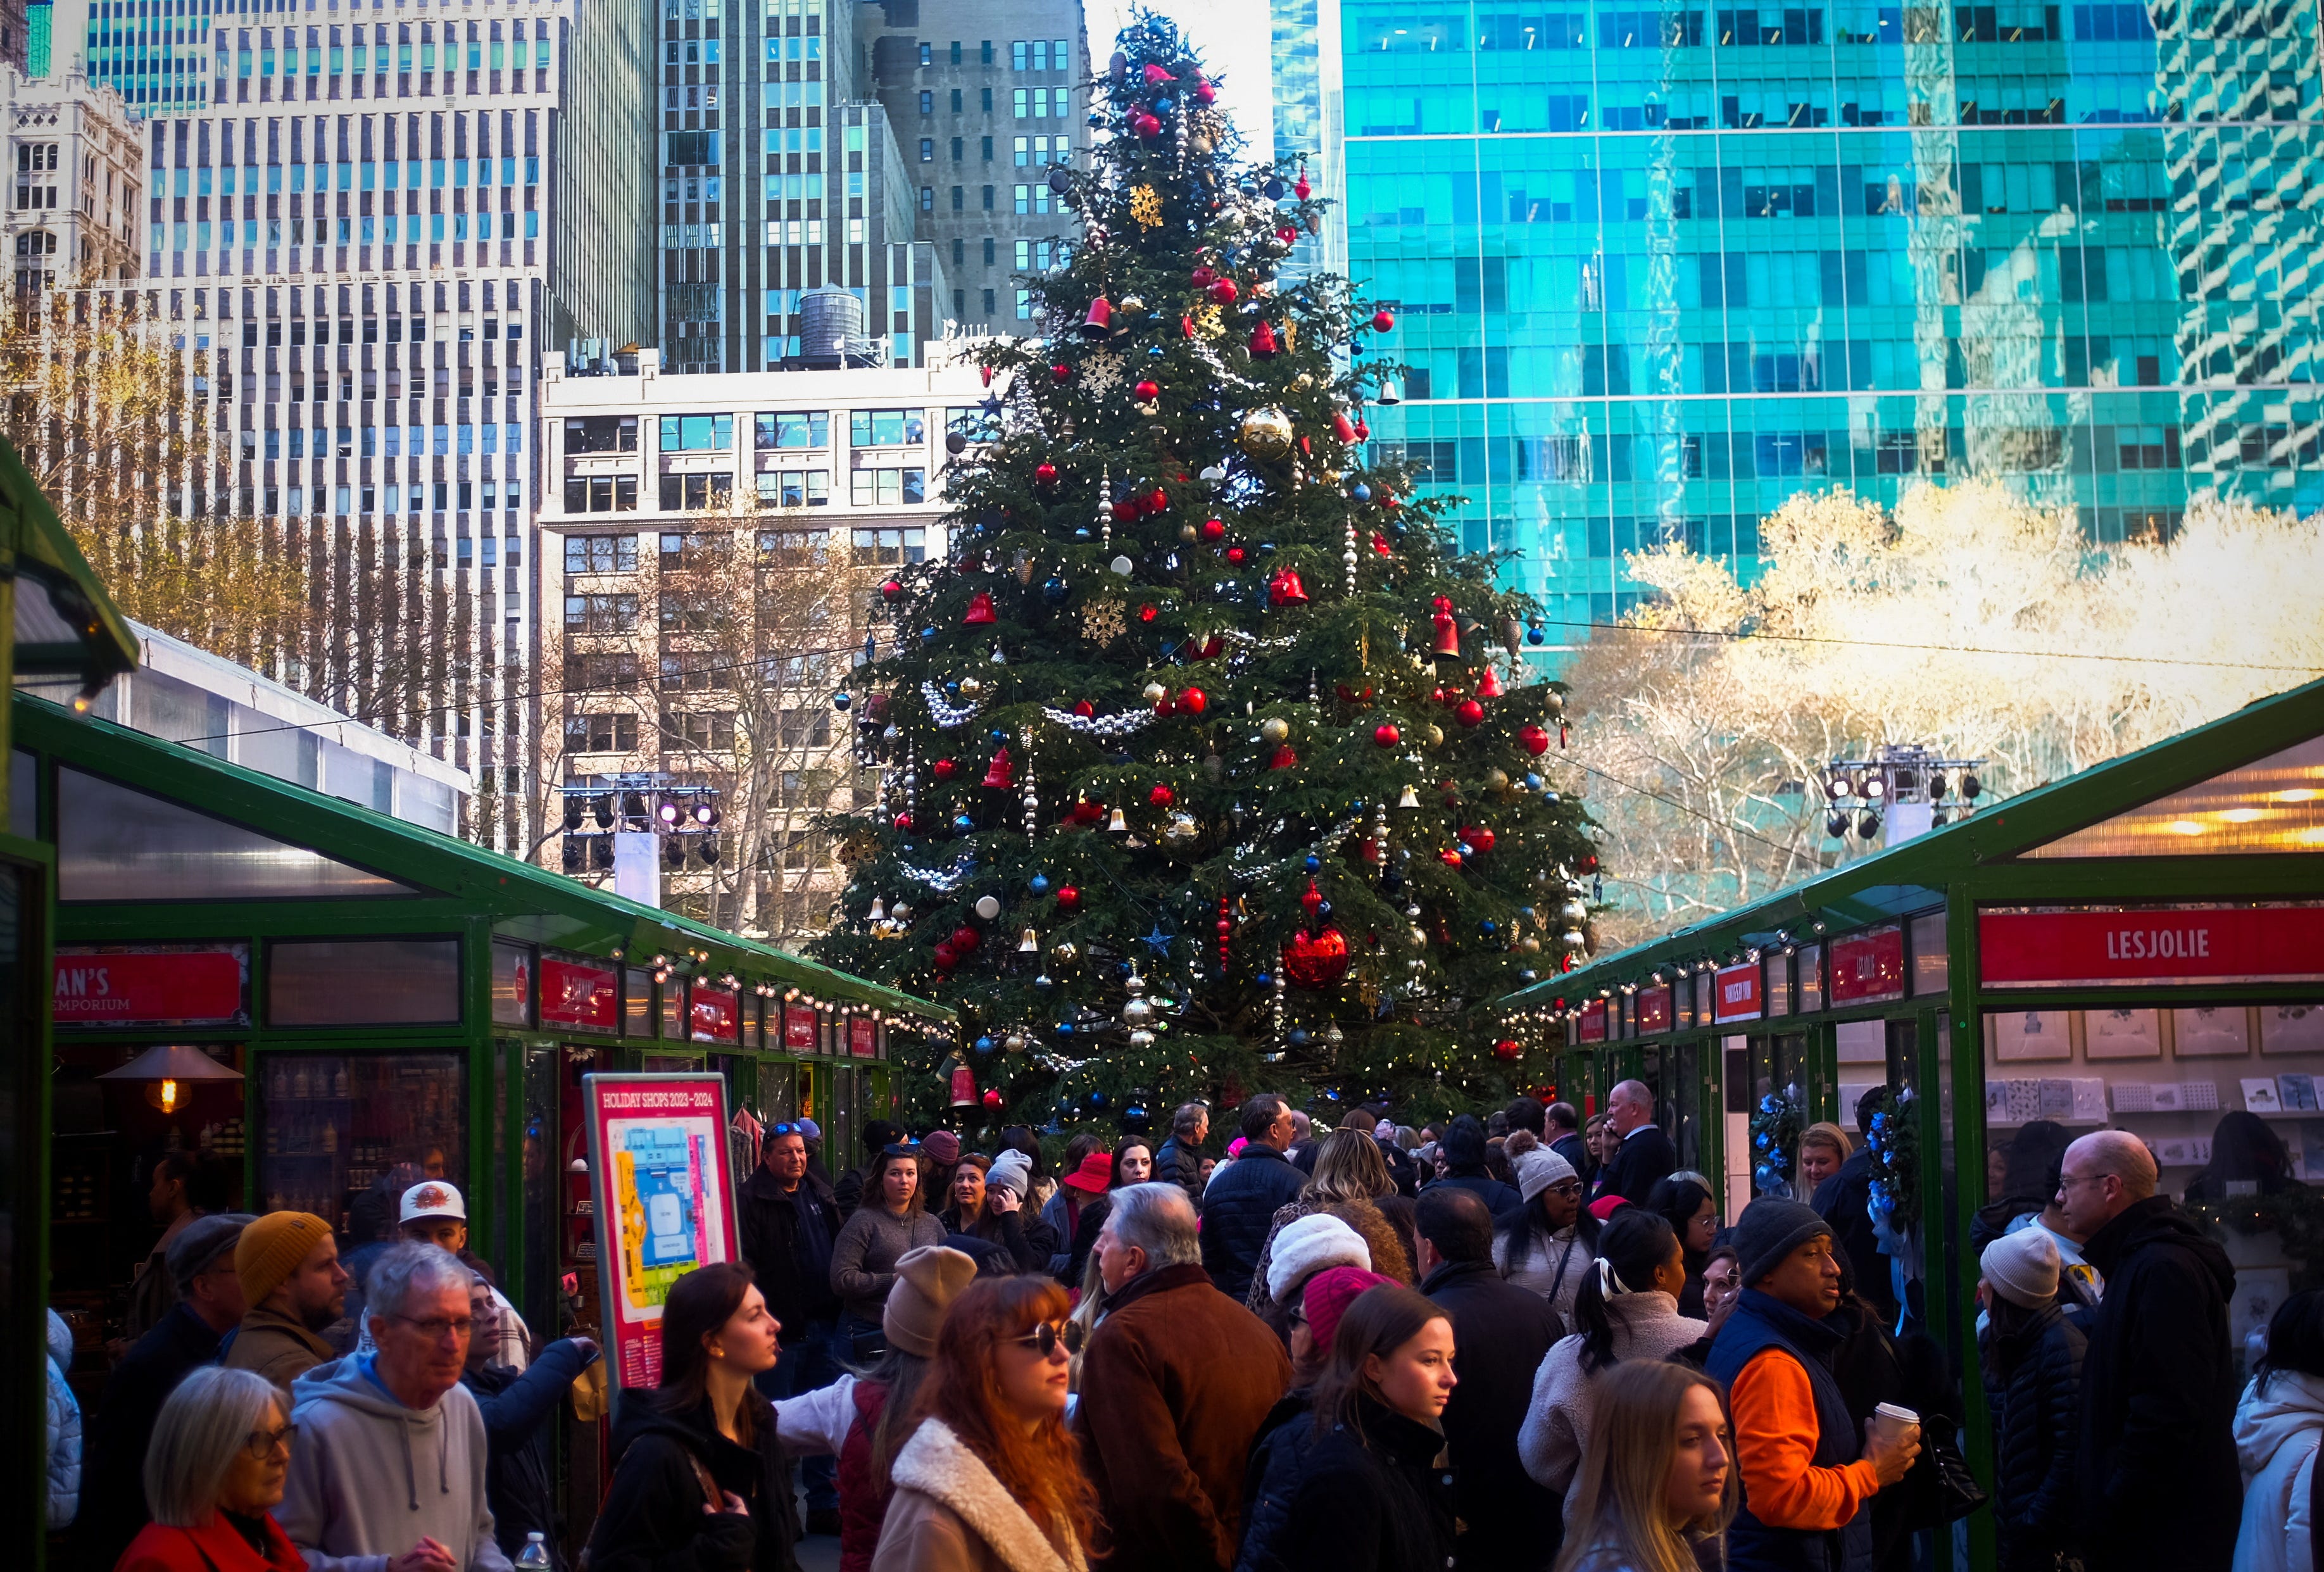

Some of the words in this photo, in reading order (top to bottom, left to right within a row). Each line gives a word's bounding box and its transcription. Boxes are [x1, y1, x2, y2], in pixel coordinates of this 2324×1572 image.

[2107, 929, 2209, 959] LESJOLIE
[603, 1093, 641, 1108] HOLIDAY
[642, 1093, 669, 1107] SHOPS
